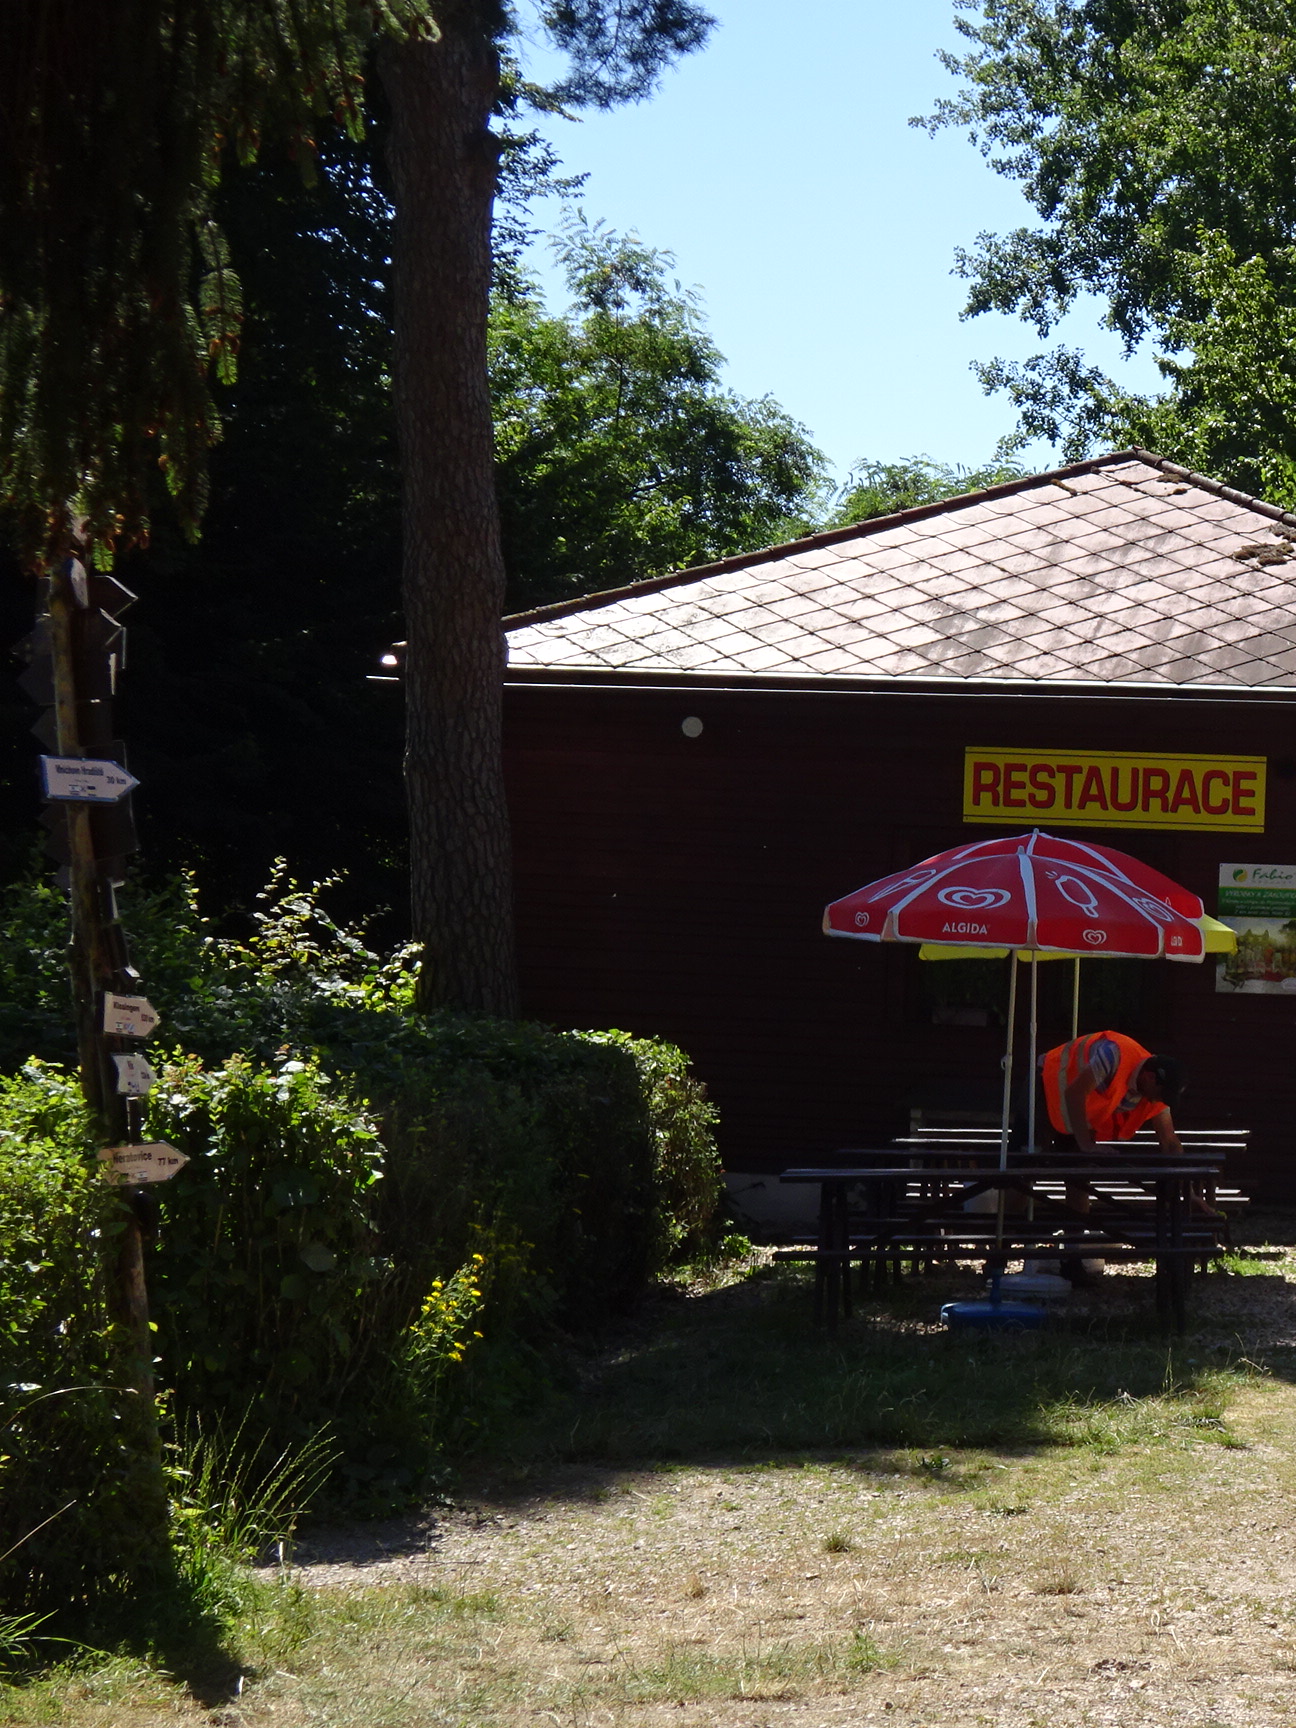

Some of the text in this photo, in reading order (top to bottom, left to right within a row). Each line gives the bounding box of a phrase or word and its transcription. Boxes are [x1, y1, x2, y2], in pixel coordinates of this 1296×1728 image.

[116, 777, 127, 785] km
[972, 761, 1257, 816] RESTAURACE
[1252, 868, 1293, 880] Fabio
[942, 922, 988, 935] ALGIDA
[112, 1150, 152, 1164] Neratovice
[157, 1156, 178, 1166] 77 km
